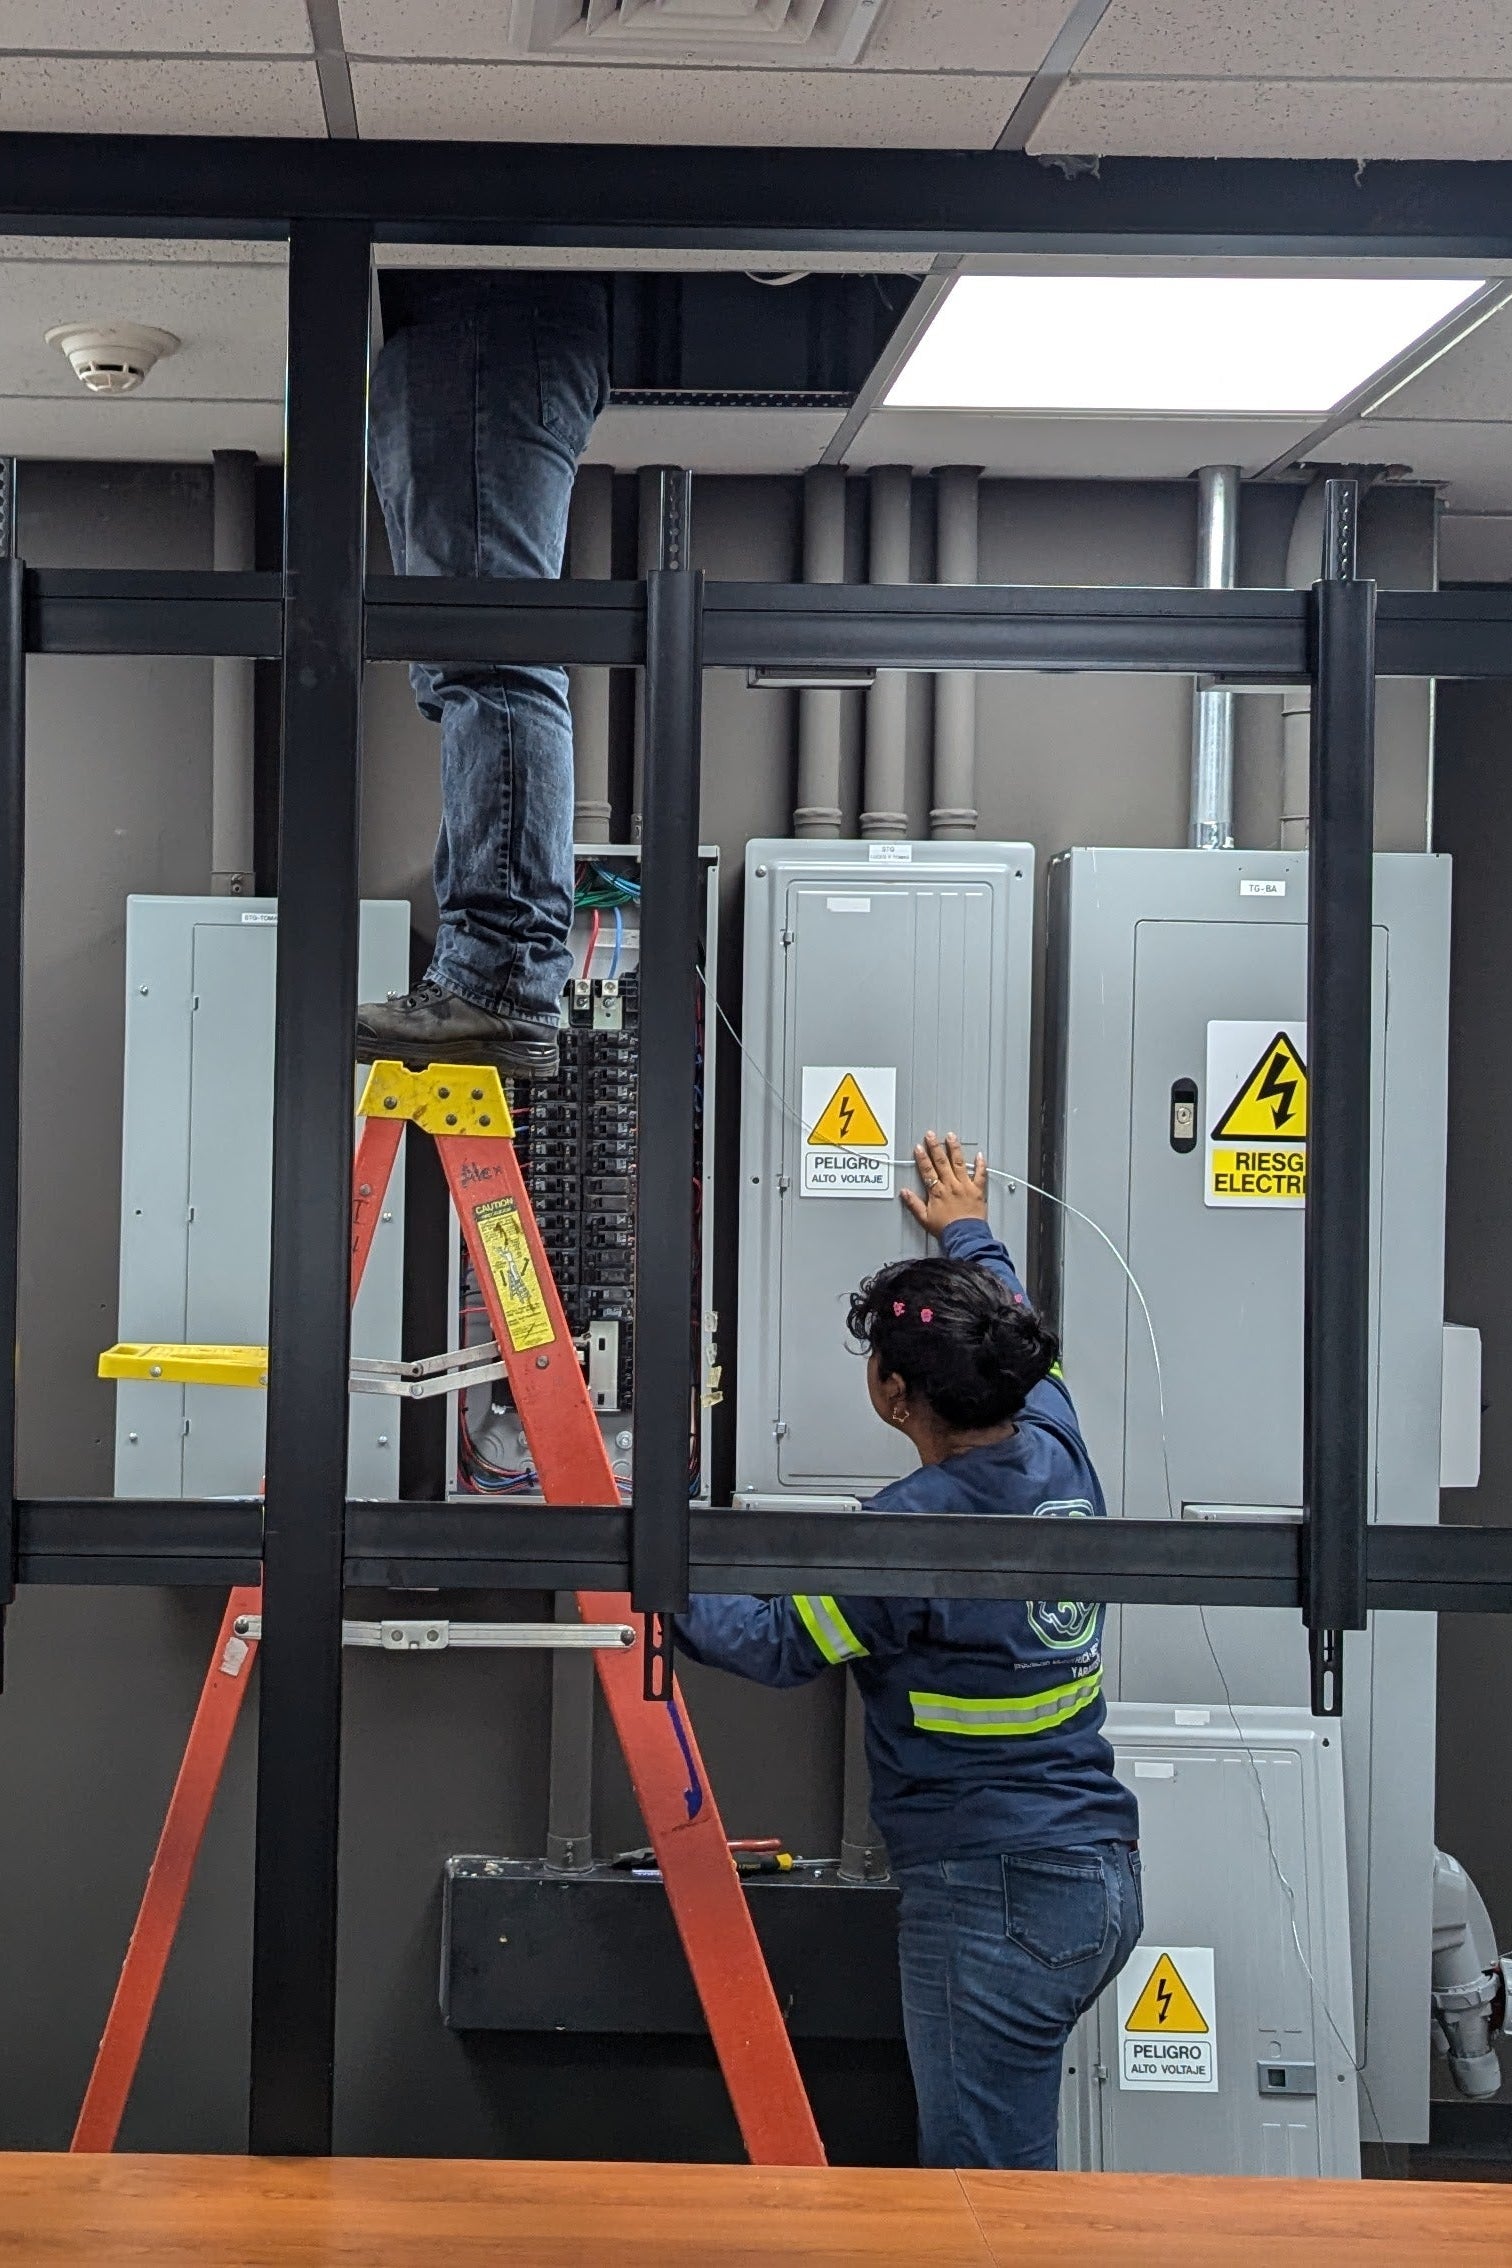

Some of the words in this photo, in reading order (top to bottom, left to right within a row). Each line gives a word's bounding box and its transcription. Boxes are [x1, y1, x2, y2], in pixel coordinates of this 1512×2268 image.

[814, 1156, 880, 1170] PELIGRO
[1236, 1152, 1304, 1172] RIESG
[811, 1174, 837, 1183] ALTO
[840, 1174, 883, 1184] VOLTAJE
[1214, 1173, 1306, 1194] ELECTRI
[475, 1197, 514, 1214] CAUTION
[1133, 2044, 1202, 2060] PELIGRO
[1131, 2064, 1157, 2074] ALTO
[1161, 2064, 1206, 2075] VOLTAJE
